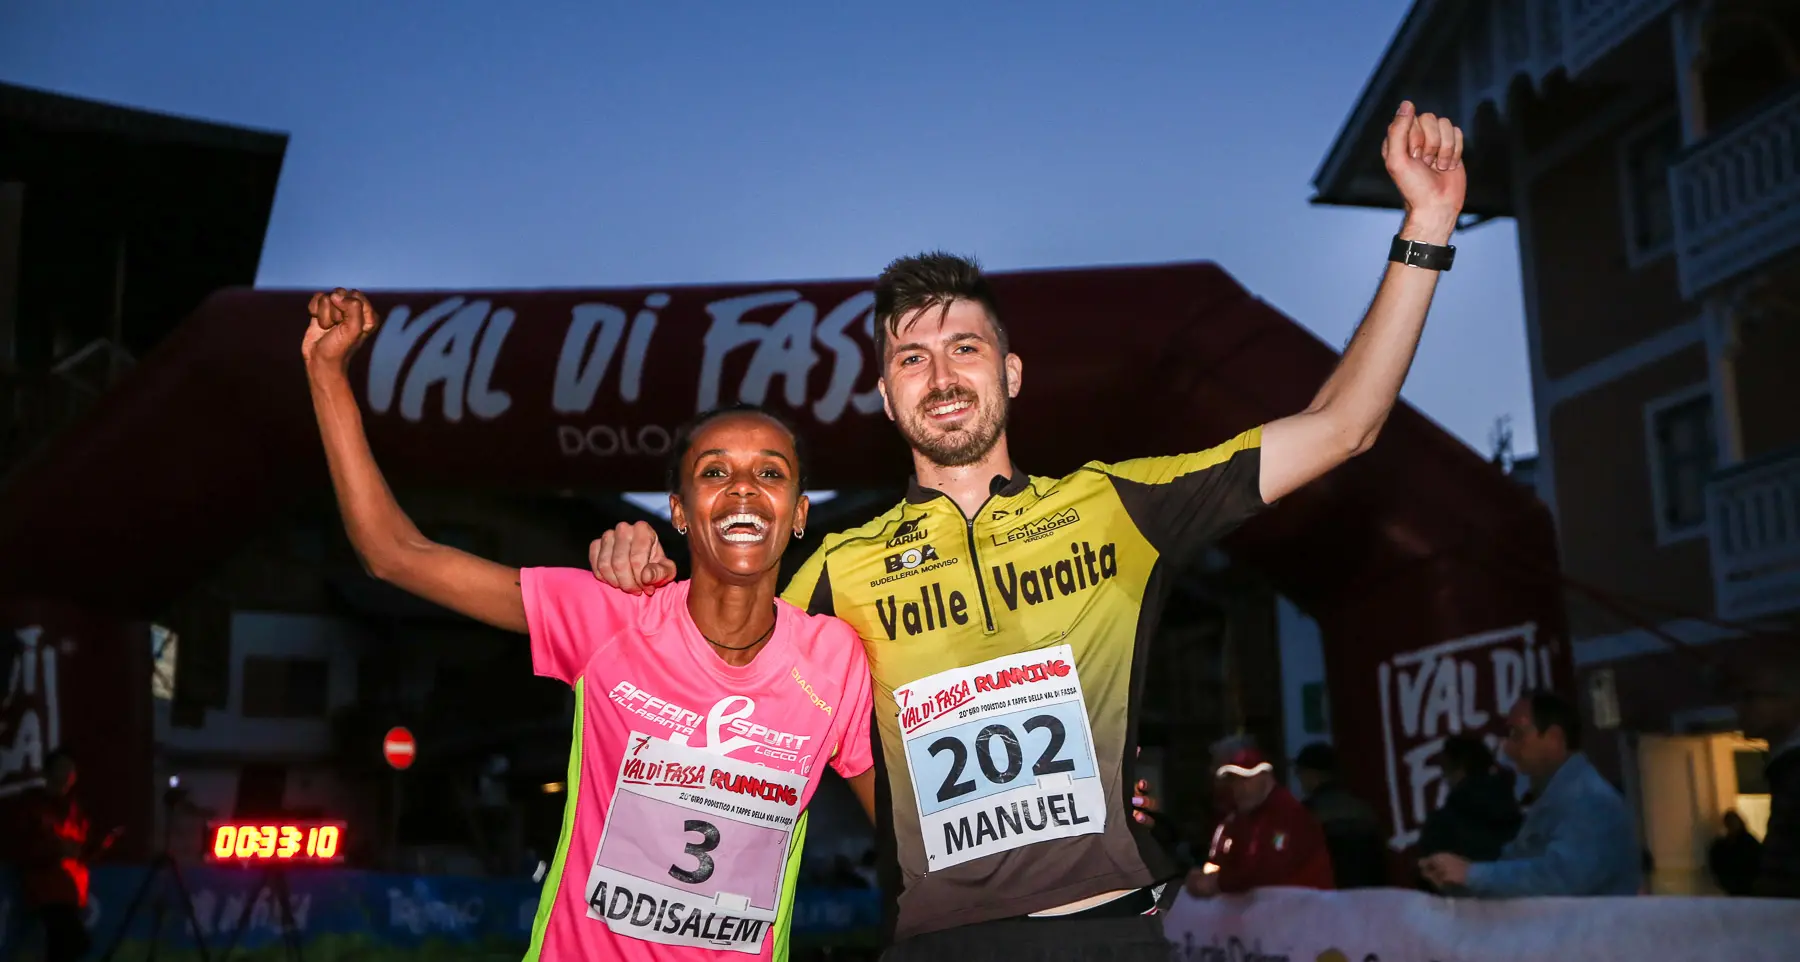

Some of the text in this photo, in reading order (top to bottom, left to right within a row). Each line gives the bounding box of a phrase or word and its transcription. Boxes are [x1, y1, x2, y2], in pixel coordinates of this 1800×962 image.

[367, 296, 517, 423] VAL
[884, 544, 939, 574] BOA
[886, 529, 928, 549] KARHU
[870, 557, 959, 588] BUDELLERIA MONVISO
[876, 541, 1118, 641] Valle Varaita
[608, 690, 695, 735] VILLASANTA
[613, 680, 704, 728] AFFARI
[727, 718, 811, 750] SPORT
[792, 667, 833, 716] DIADORA
[902, 706, 922, 729] VAL
[936, 680, 970, 713] FASSA
[974, 659, 1071, 693] RUNNING
[981, 699, 1006, 713] PODISTICO
[1007, 699, 1012, 707] A
[1011, 696, 1028, 706] TAPPE
[1028, 694, 1044, 704] DELLA
[1044, 691, 1054, 699] VAL
[1060, 686, 1077, 697] FASSA
[1397, 653, 1490, 738] VAL
[623, 758, 645, 780] VAL
[664, 763, 705, 785] FASSA
[710, 768, 798, 807] RUNNING
[927, 714, 1076, 803] 202
[703, 798, 730, 812] PODISTICO
[730, 805, 735, 813] A
[735, 806, 752, 817] TAPPE
[751, 810, 766, 820] DELLA
[766, 813, 775, 822] VAL
[943, 793, 1089, 855] MANUEL
[667, 819, 721, 884] 3
[589, 880, 764, 943] ADDISALEM
